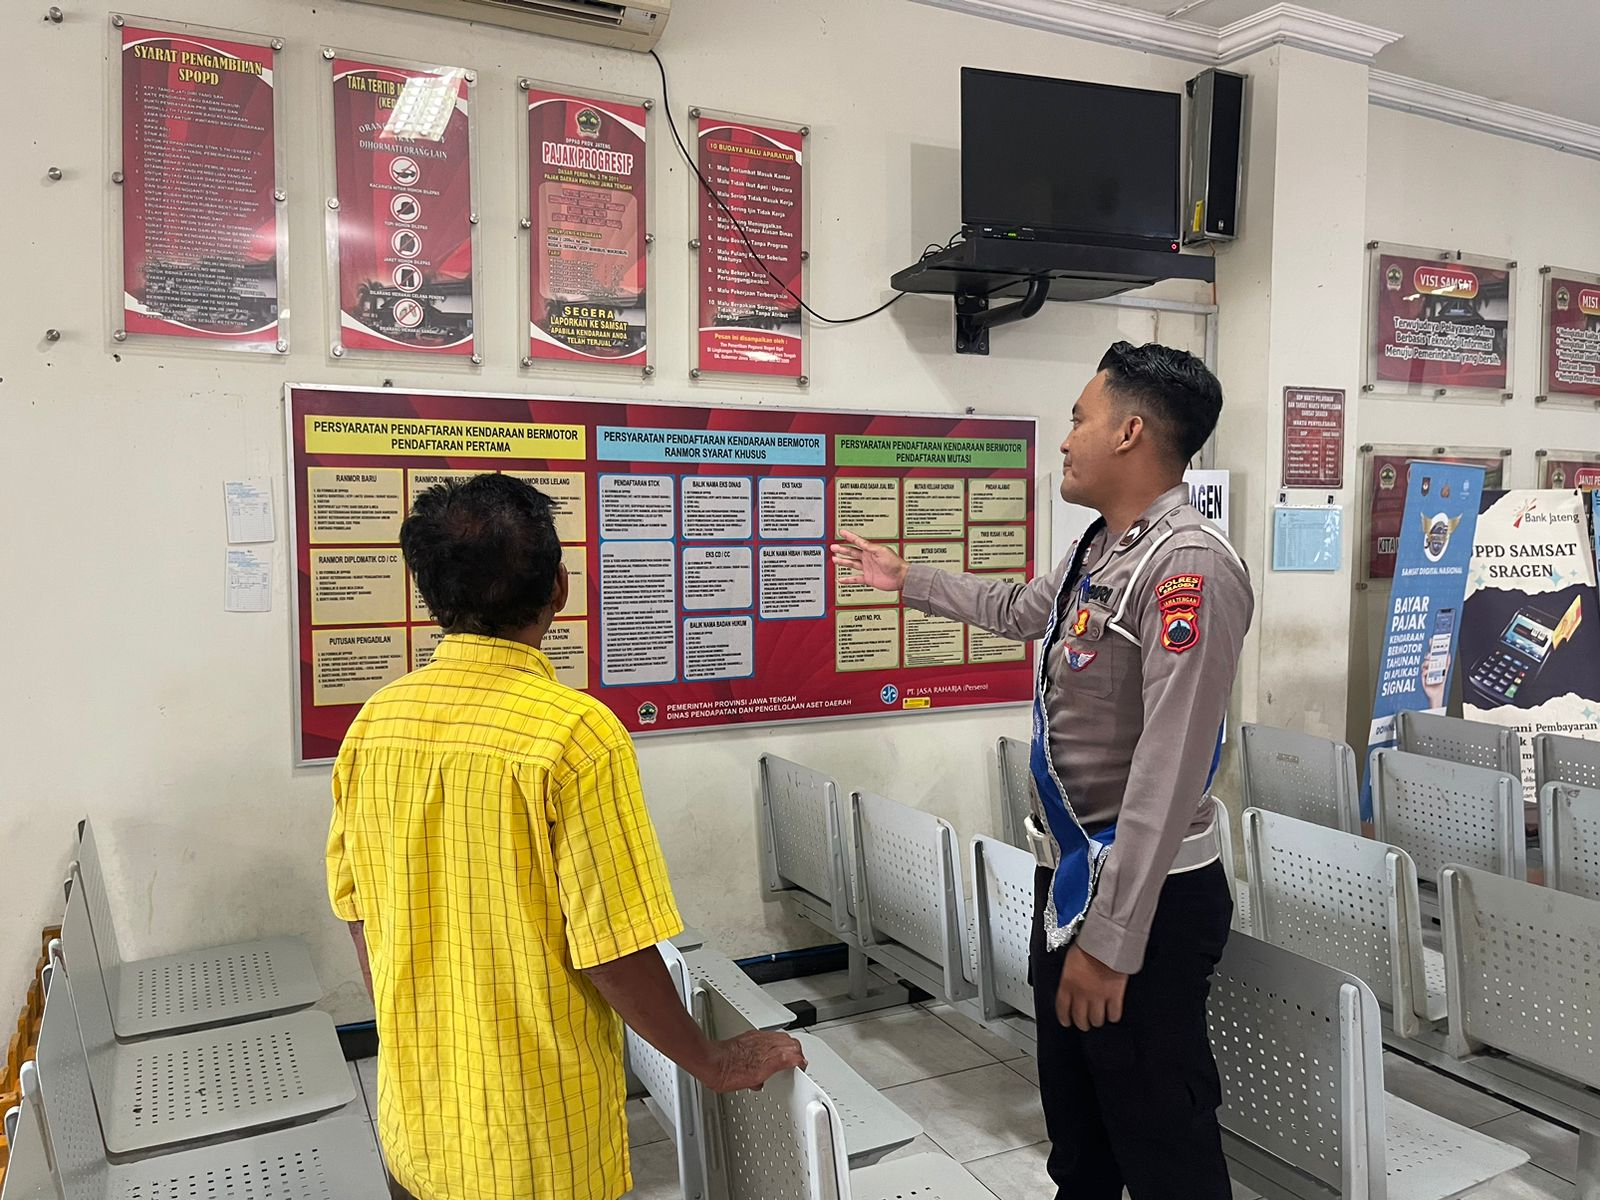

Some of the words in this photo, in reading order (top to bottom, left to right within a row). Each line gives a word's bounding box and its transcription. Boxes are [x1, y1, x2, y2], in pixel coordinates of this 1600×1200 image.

[134, 45, 178, 62] SYARAT
[181, 51, 263, 75] PENGAMBILAN
[178, 68, 219, 85] SPOPD
[346, 75, 367, 91] TATA
[367, 78, 395, 95] TERTIB
[360, 140, 403, 153] DIHORMATI
[403, 146, 430, 157] ORANG
[430, 148, 448, 159] LAIN
[595, 141, 611, 149] JATENG
[718, 143, 743, 153] BUDAYA
[744, 146, 762, 156] MALU
[762, 149, 794, 161] APARATUR
[542, 141, 577, 168] PAJAK
[577, 147, 634, 176] PROGRESIF
[716, 164, 730, 172] Malu
[730, 166, 756, 176] Terlambat
[757, 170, 773, 178] Masuk
[774, 172, 791, 180] Kantor
[544, 173, 560, 181] PAJAK
[559, 175, 579, 184] DAERAH
[579, 177, 600, 186] PROVINSI
[600, 180, 614, 189] JAWA
[614, 182, 633, 191] TENGAH
[369, 183, 392, 191] KACAMATA
[423, 189, 441, 197] DILEPAS
[730, 192, 747, 201] Sering
[748, 194, 762, 202] Tidak
[762, 196, 779, 204] Masuk
[779, 198, 794, 207] Kerja
[717, 274, 770, 286] Pertanggungjawaban
[730, 269, 750, 278] Bekerja
[751, 271, 766, 279] Tanpa
[1420, 274, 1439, 288] VISI
[1440, 276, 1473, 291] SAMSAT
[1582, 295, 1599, 309] MISI
[564, 305, 615, 320] SEGERA
[550, 316, 588, 328] LAPORKAN
[589, 319, 600, 329] KE
[600, 320, 628, 331] SAMSAT
[1393, 316, 1440, 333] Terwujudnya
[1440, 321, 1476, 336] Pelayanan
[1475, 325, 1496, 338] Prima
[550, 327, 575, 336] APABILA
[576, 329, 611, 339] KENDARAAN
[611, 331, 628, 340] ANDA
[714, 333, 732, 341] Pesan
[739, 335, 773, 344] disampaikan
[567, 336, 586, 346] TELAH
[586, 338, 613, 348] TERJUAL
[1395, 331, 1426, 345] Berbasis
[1426, 334, 1460, 350] Teknologi
[1460, 338, 1493, 352] Informasi
[1385, 344, 1414, 360] Menuju
[1413, 347, 1460, 362] Pemerintahan
[1460, 352, 1479, 366] yang
[1479, 353, 1501, 366] bersih.
[314, 421, 389, 434] PERSYARATAN
[391, 423, 463, 437] PENDAFTARAN
[465, 426, 525, 439] KENDARAAN
[527, 428, 579, 441] BERMOTOR
[391, 438, 464, 451] PENDAFTARAN
[466, 441, 511, 453] PERTAMA
[604, 431, 665, 444] PERSYARATAN
[667, 433, 726, 446] PENDAFTARAN
[727, 436, 776, 447] KENDARAAN
[777, 437, 820, 449] BERMOTOR
[840, 439, 892, 450] PERSYARATAN
[892, 441, 942, 451] PENDAFTARAN
[943, 442, 985, 452] KENDARAAN
[986, 443, 1022, 453] BERMOTOR
[664, 447, 701, 458] RANMOR
[702, 448, 733, 458] SYARAT
[734, 449, 767, 460] KHUSUS
[896, 453, 946, 463] PENDAFTARAN
[947, 454, 972, 464] MUTASI
[335, 474, 361, 483] RANMOR
[361, 475, 377, 483] BARU
[539, 478, 550, 486] EKS
[550, 478, 570, 486] LELANG
[613, 479, 648, 487] PENDAFTARAN
[692, 480, 706, 488] BALIK
[719, 481, 729, 489] EKS
[1524, 513, 1547, 523] Bank
[1549, 513, 1580, 525] Jateng
[1378, 536, 1396, 554] KITA
[1471, 544, 1506, 558] PPD
[1509, 543, 1577, 558] SAMSAT
[318, 556, 344, 564] RANMOR
[344, 555, 378, 564] DIPLOMATIK
[1489, 564, 1554, 579] SRAGEN
[1158, 576, 1199, 593] POLRES
[1394, 596, 1430, 614] BAYAR
[690, 621, 703, 629] BALIK
[731, 620, 747, 628] HUKUM
[1391, 613, 1428, 633] PAJAK
[329, 637, 356, 646] PUTUSAN
[356, 636, 392, 645] PENGADILAN
[1389, 633, 1425, 645] KENDARAAN
[1387, 643, 1423, 657] BERMOTOR
[1386, 656, 1421, 669] TAHUNAN
[1383, 671, 1391, 681] DI
[1391, 667, 1420, 680] APLIKASI
[906, 688, 915, 696] PT.
[916, 687, 932, 696] JASA
[933, 685, 962, 694] RAHARJA
[962, 683, 990, 693] (Persero)
[1381, 678, 1417, 697] SIGNAL
[666, 701, 714, 712] PEMERINTAH
[714, 699, 748, 709] PROVINSI
[748, 698, 768, 706] JAWA
[768, 695, 797, 704] TENGAH
[666, 711, 690, 721] DINAS
[690, 708, 737, 718] PENDAPATAN
[738, 706, 754, 714] DAN
[754, 702, 805, 713] PENGELOLAAN
[805, 701, 823, 709] ASET
[824, 699, 852, 708] DAERAH
[1535, 721, 1598, 734] Pembayaran
